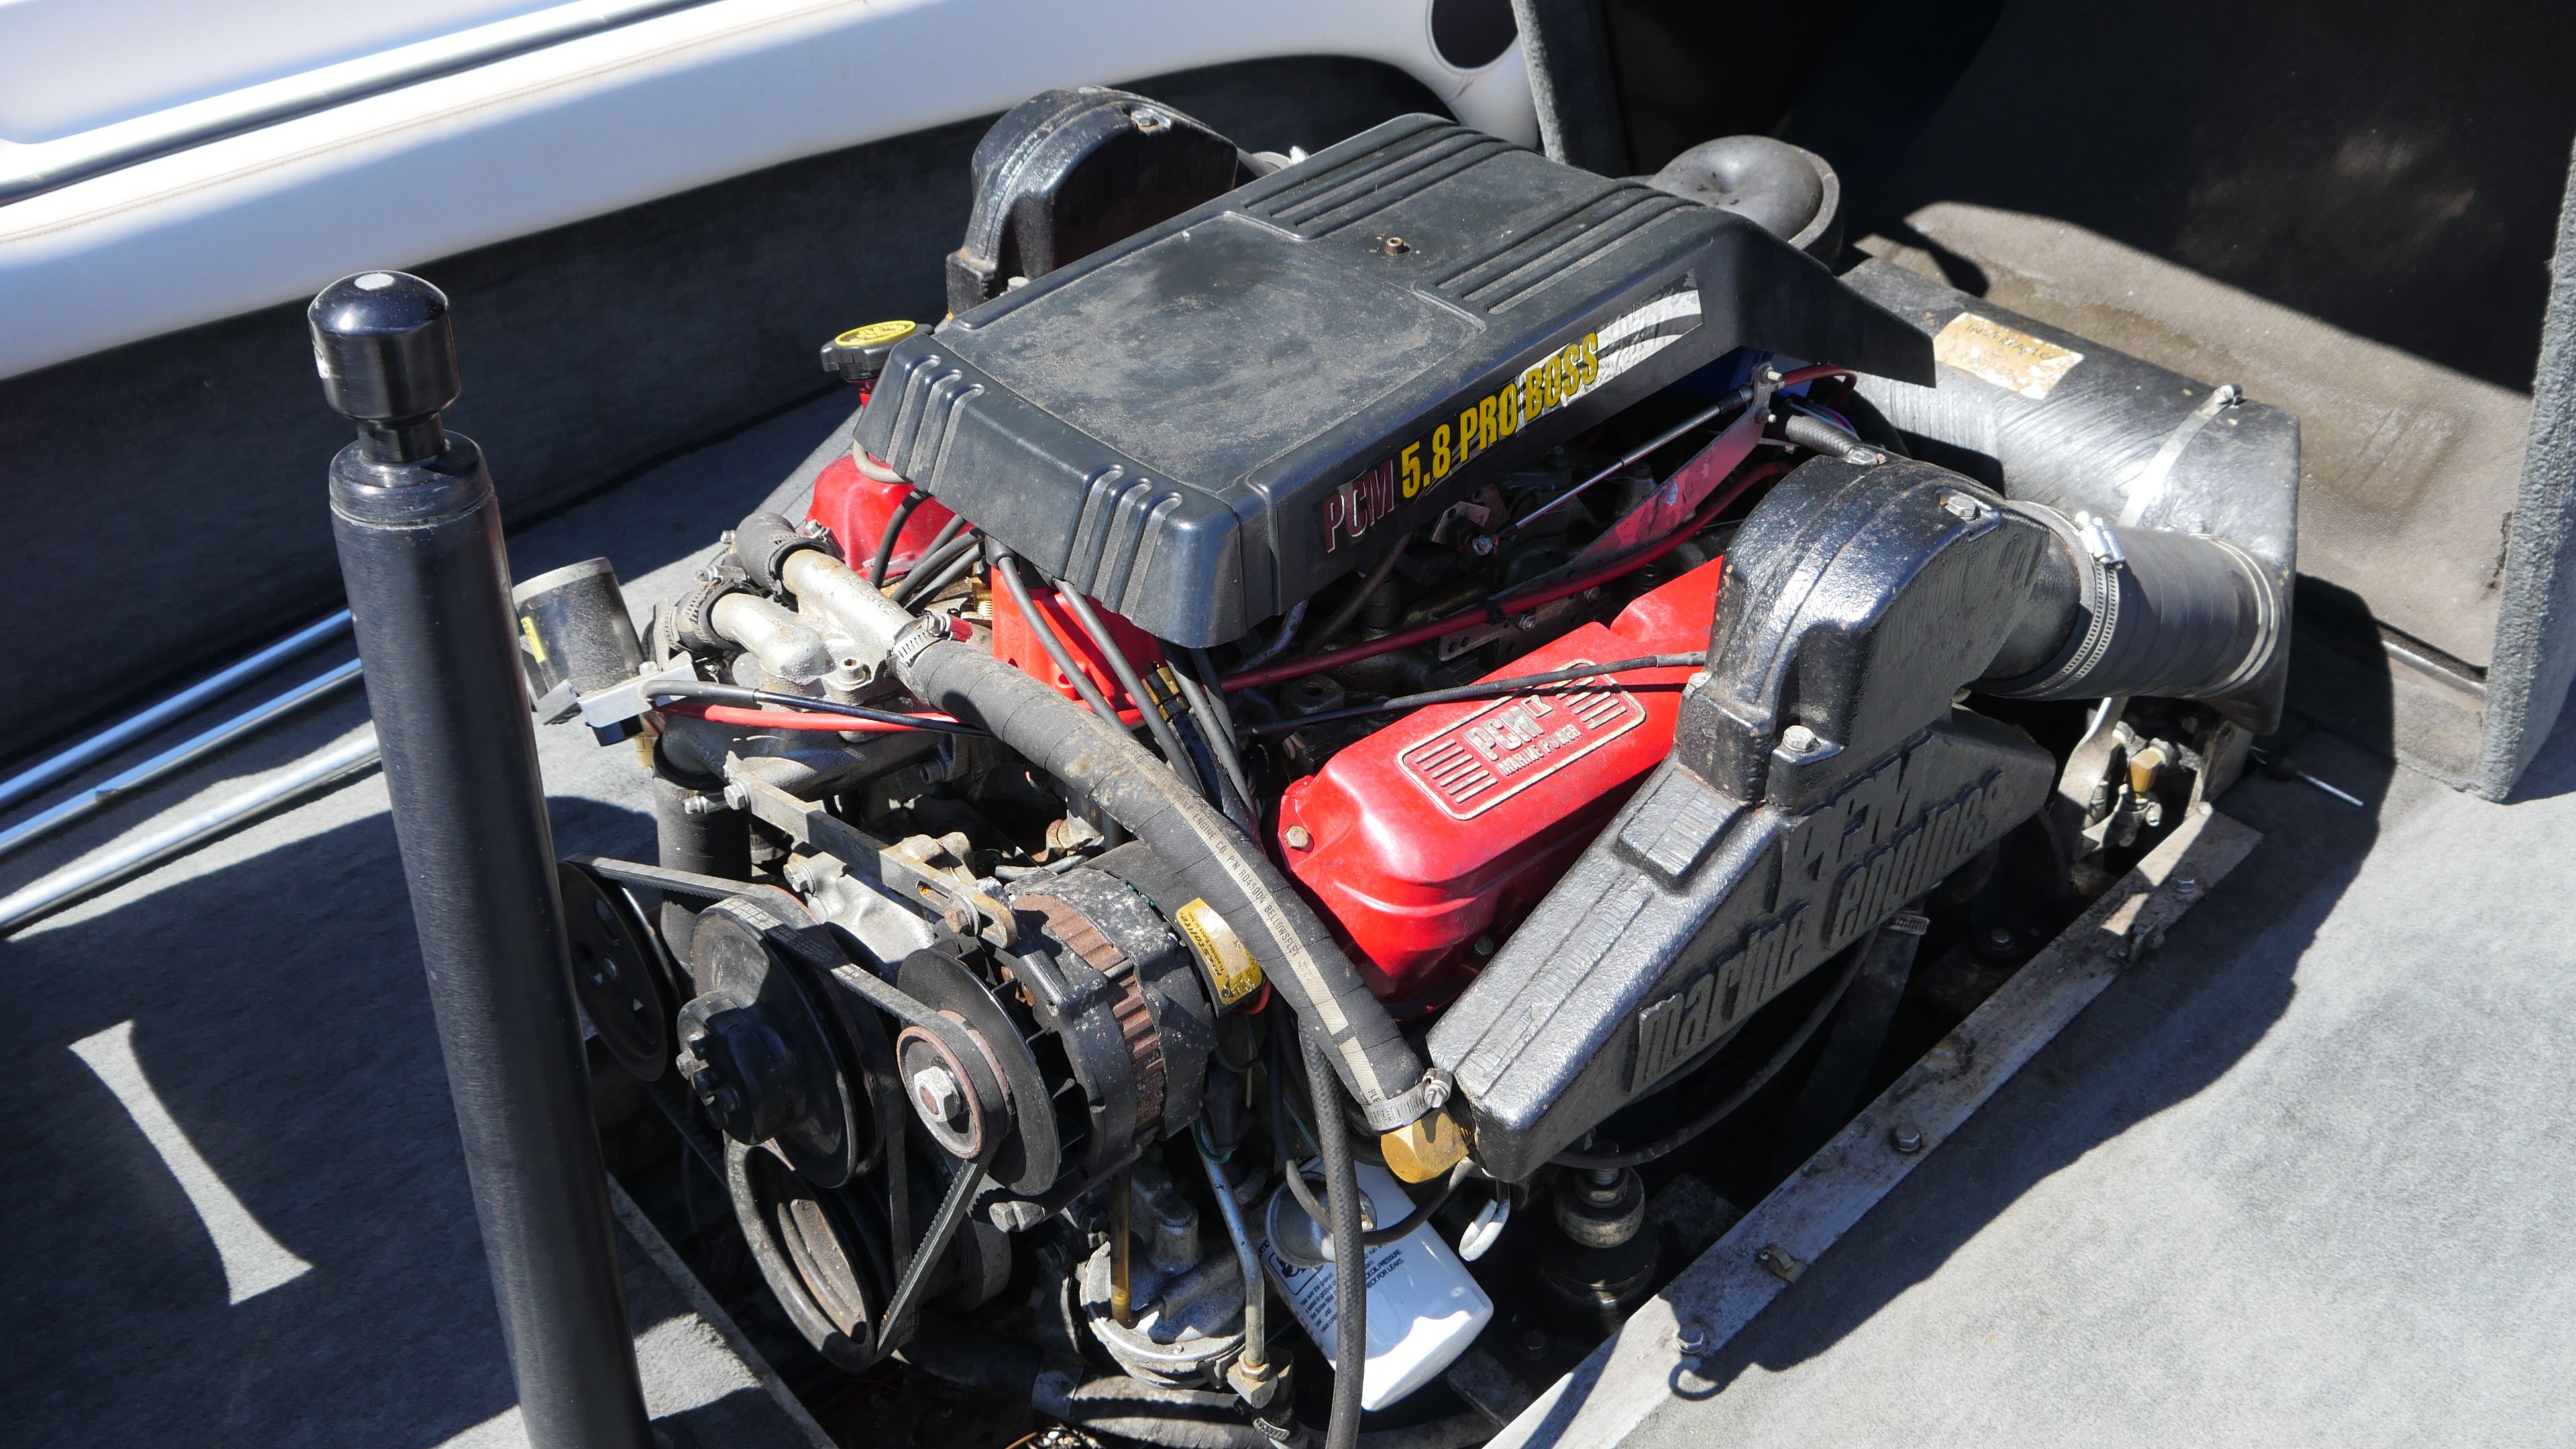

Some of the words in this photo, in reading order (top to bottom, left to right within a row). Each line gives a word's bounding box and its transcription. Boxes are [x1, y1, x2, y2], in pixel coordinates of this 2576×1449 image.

[1322, 460, 1395, 553] PCM
[1401, 423, 1451, 499] 5.8
[1459, 382, 1518, 464] PRO
[1524, 331, 1599, 422] BOSS
[1463, 705, 1545, 761] PCM
[1496, 745, 1545, 776] MARINE
[1538, 723, 1582, 753] POWER
[1191, 812, 1217, 841] ENGINE
[1226, 855, 1240, 870] P/N
[1264, 904, 1301, 959] BELLOWSFLEX
[1377, 1269, 1389, 1280] FOR
